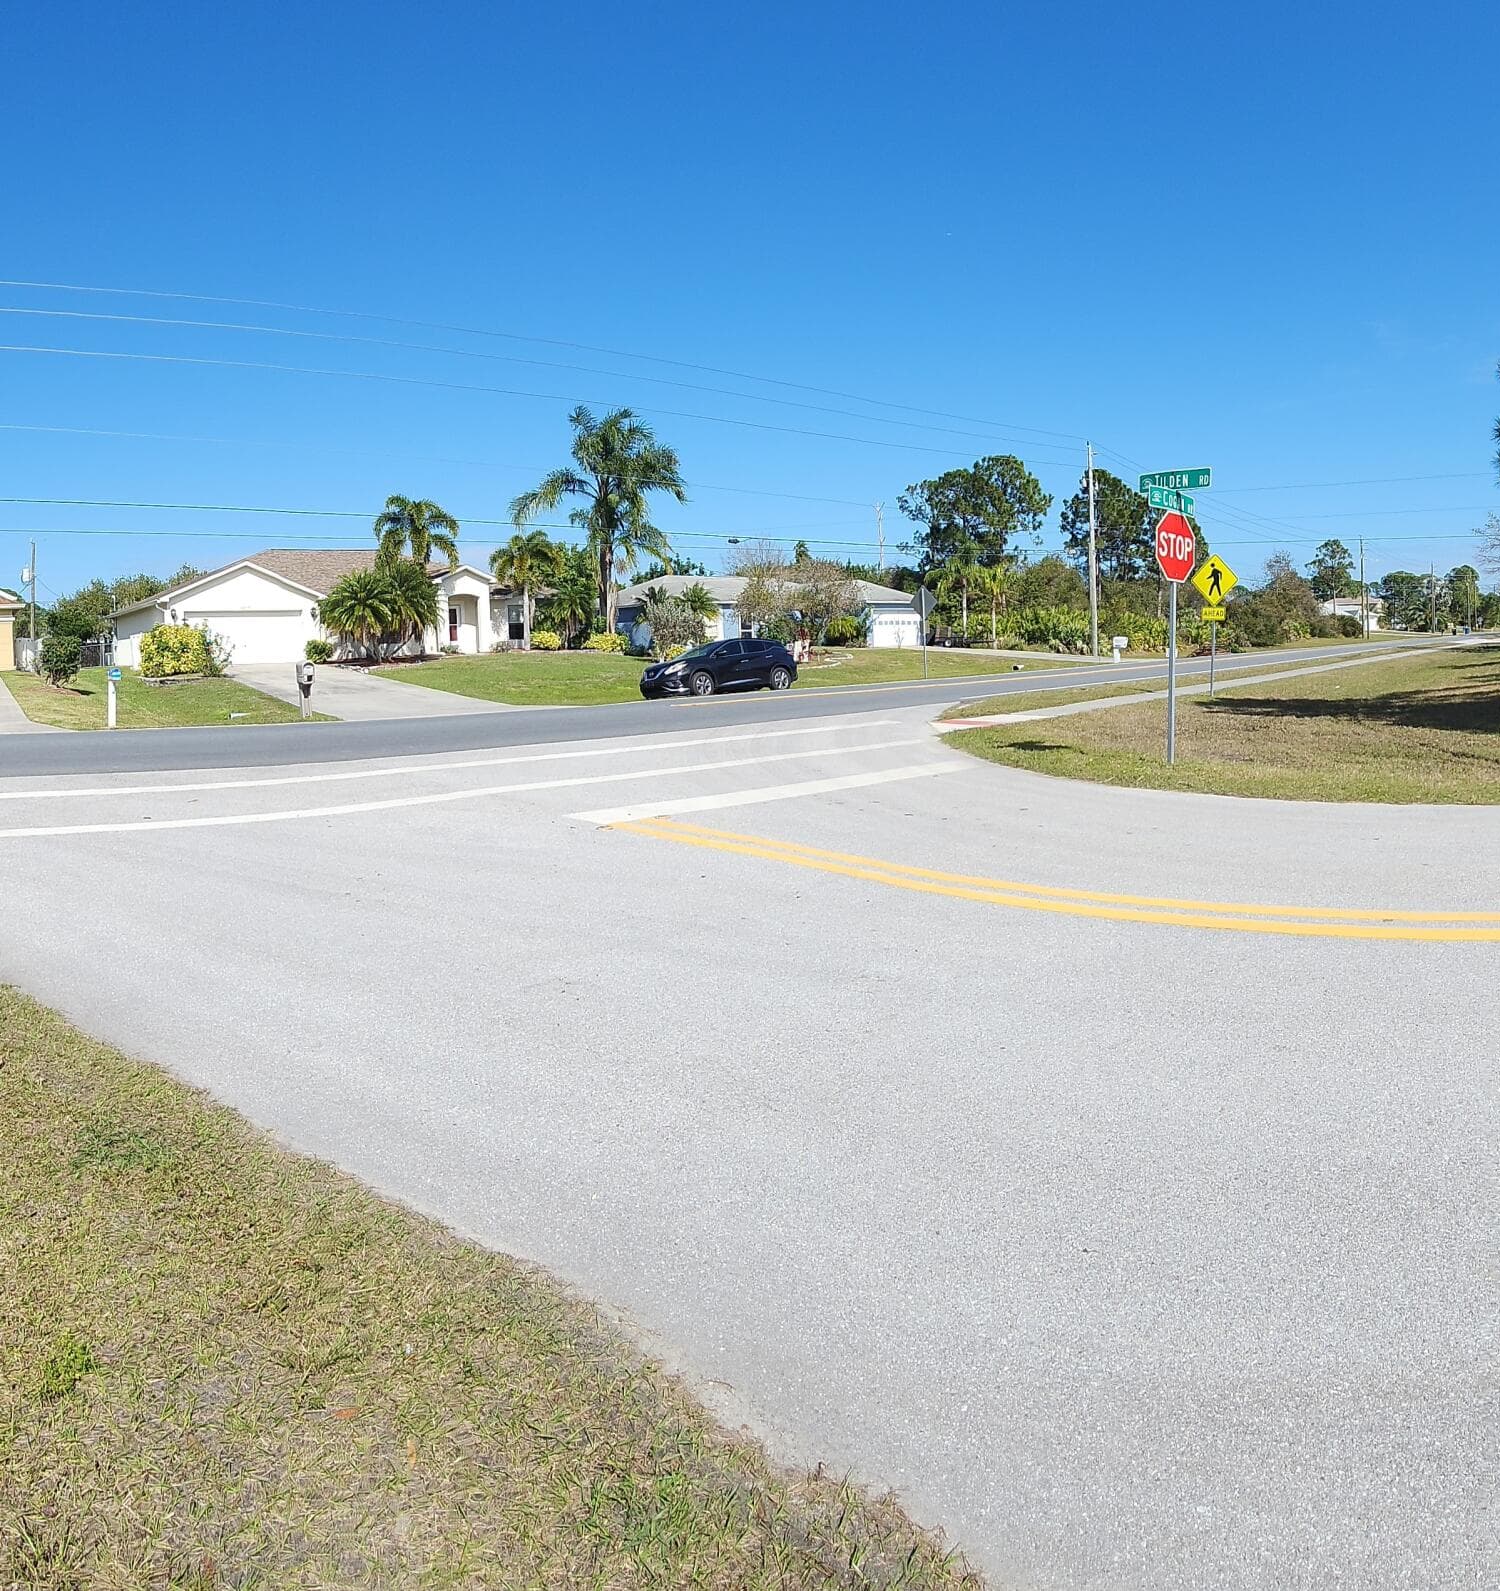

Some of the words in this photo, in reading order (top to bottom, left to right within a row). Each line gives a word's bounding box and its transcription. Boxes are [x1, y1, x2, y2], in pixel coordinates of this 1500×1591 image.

[1155, 474, 1189, 489] TILDEN
[1199, 475, 1208, 485] RD
[1159, 531, 1192, 561] STOP
